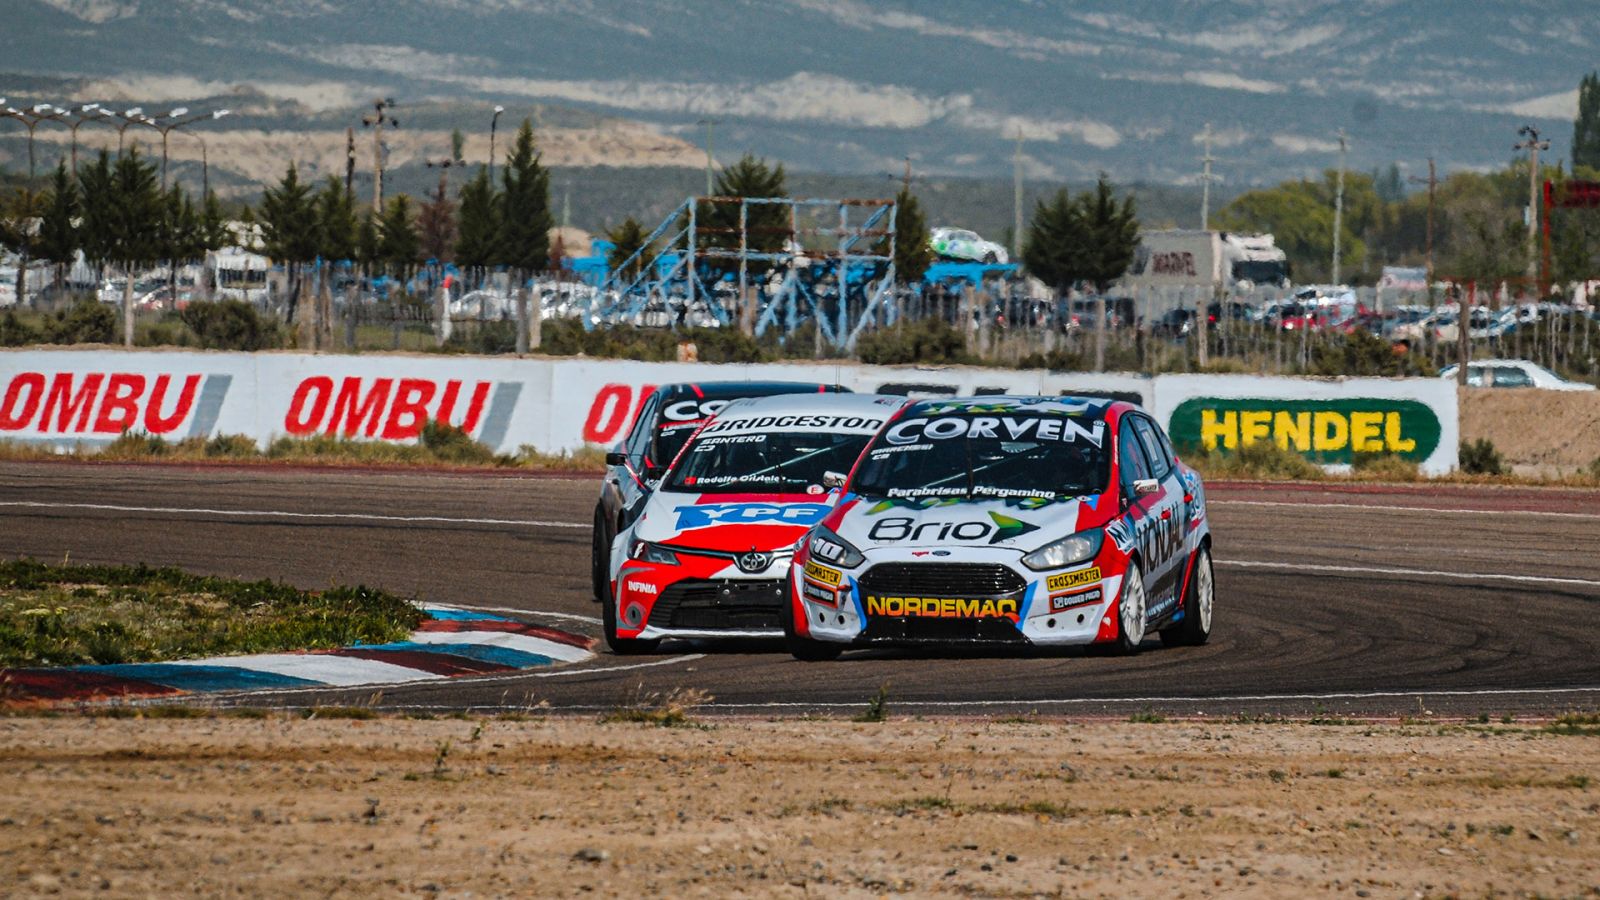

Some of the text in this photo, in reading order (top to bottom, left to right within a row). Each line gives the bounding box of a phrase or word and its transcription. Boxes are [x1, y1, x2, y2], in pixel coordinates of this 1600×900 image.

[0, 372, 201, 434] OMBU
[285, 375, 490, 439] OMBU
[702, 435, 767, 444] SANTERO
[885, 417, 1105, 449] CORVEN
[1200, 409, 1416, 453] HENDEL
[888, 486, 1055, 498] Parabrisas Pergamino
[699, 508, 818, 519] YPF
[868, 517, 992, 541] Brio
[814, 538, 843, 560] 10
[628, 581, 657, 594] INFINIA
[1049, 569, 1100, 588] CROSSMASTER
